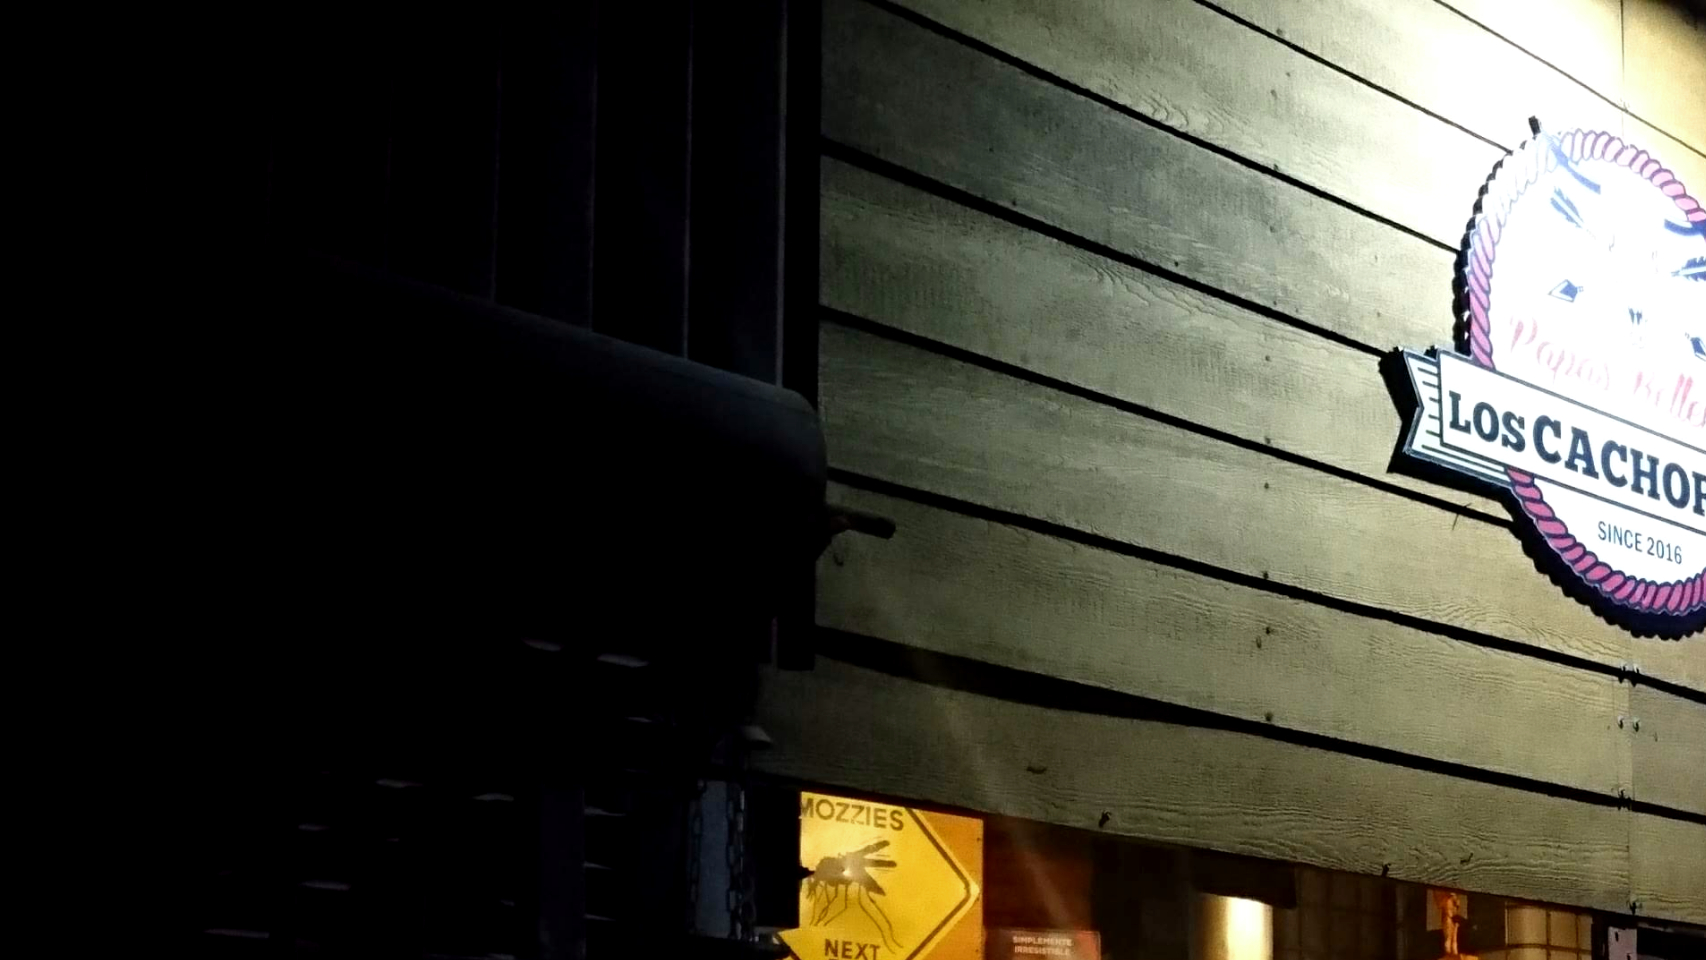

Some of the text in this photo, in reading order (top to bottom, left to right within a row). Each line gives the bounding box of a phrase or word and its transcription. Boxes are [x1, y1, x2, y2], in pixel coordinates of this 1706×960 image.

[1449, 390, 1526, 452] LOS
[1597, 520, 1683, 564] SINCE 2016
[801, 797, 904, 832] MOZZIES
